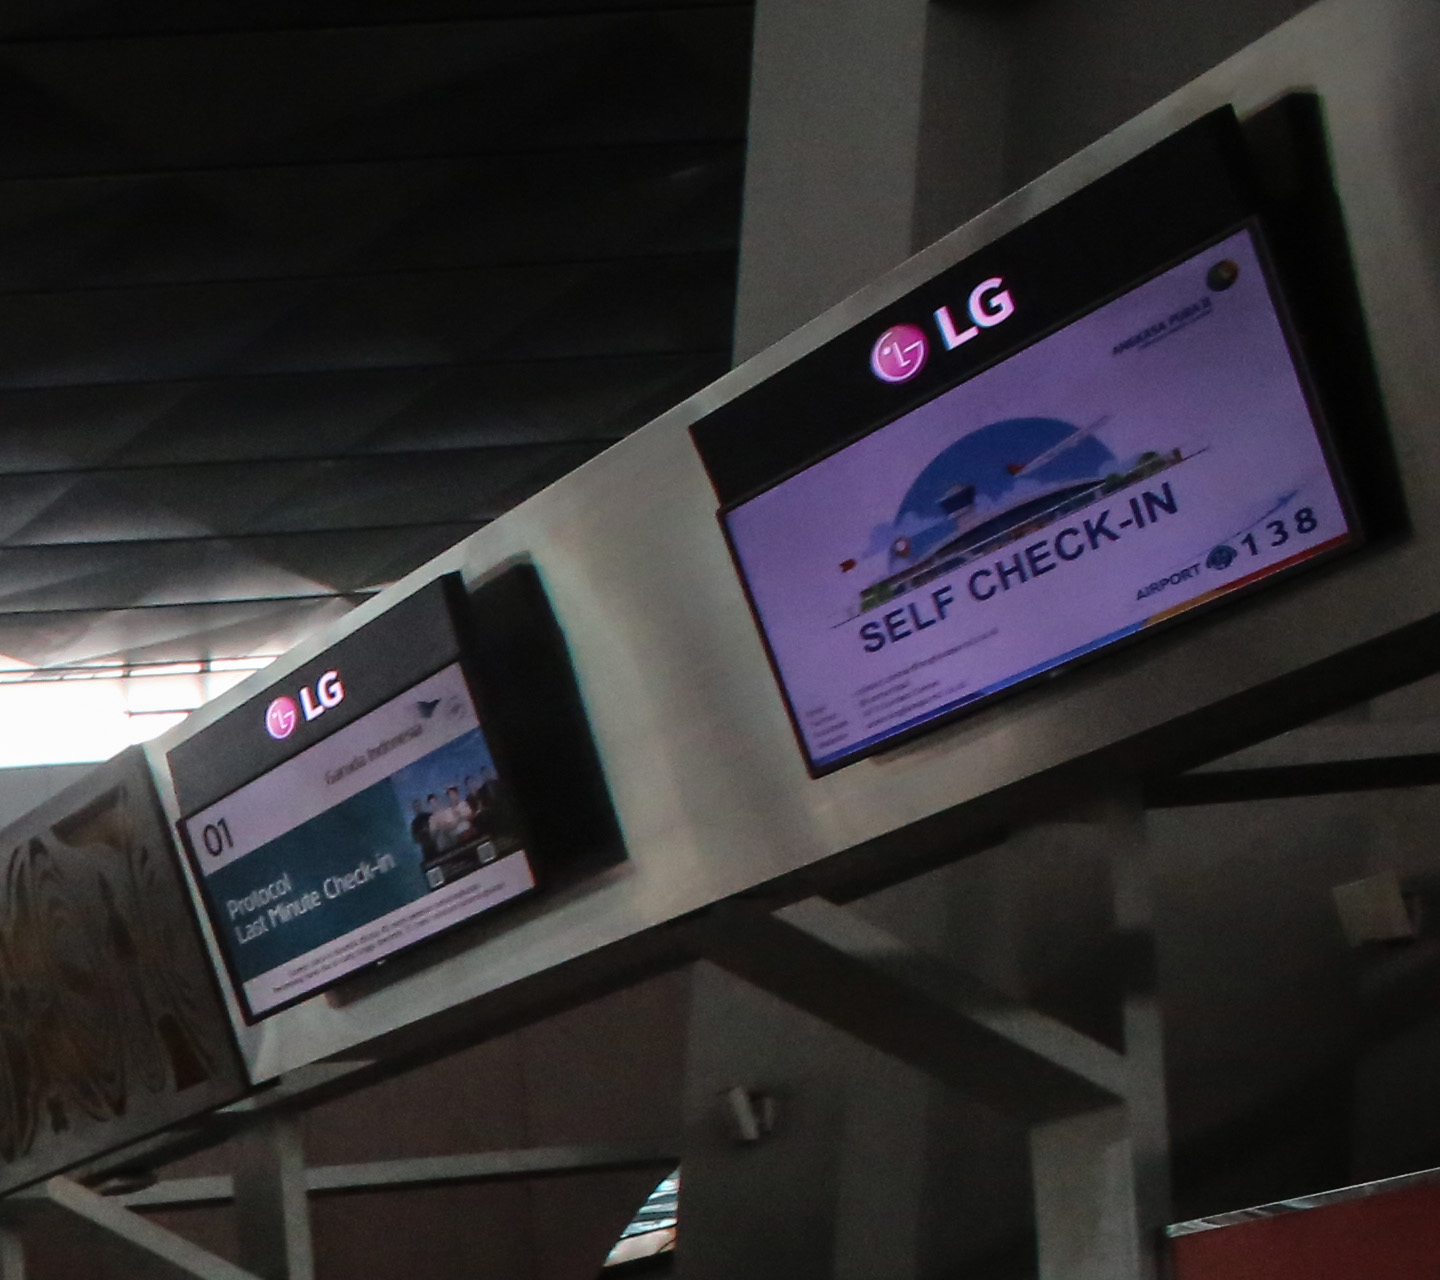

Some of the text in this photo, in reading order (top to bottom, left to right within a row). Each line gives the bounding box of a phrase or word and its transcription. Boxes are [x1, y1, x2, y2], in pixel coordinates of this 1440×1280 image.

[933, 276, 1017, 351] LG
[859, 481, 1178, 653] SELF CHECK-IN
[1136, 563, 1201, 601] AIRPORT
[298, 669, 346, 722] LG
[201, 816, 235, 859] 01
[234, 914, 268, 946] Last
[323, 851, 396, 901] Check-in
